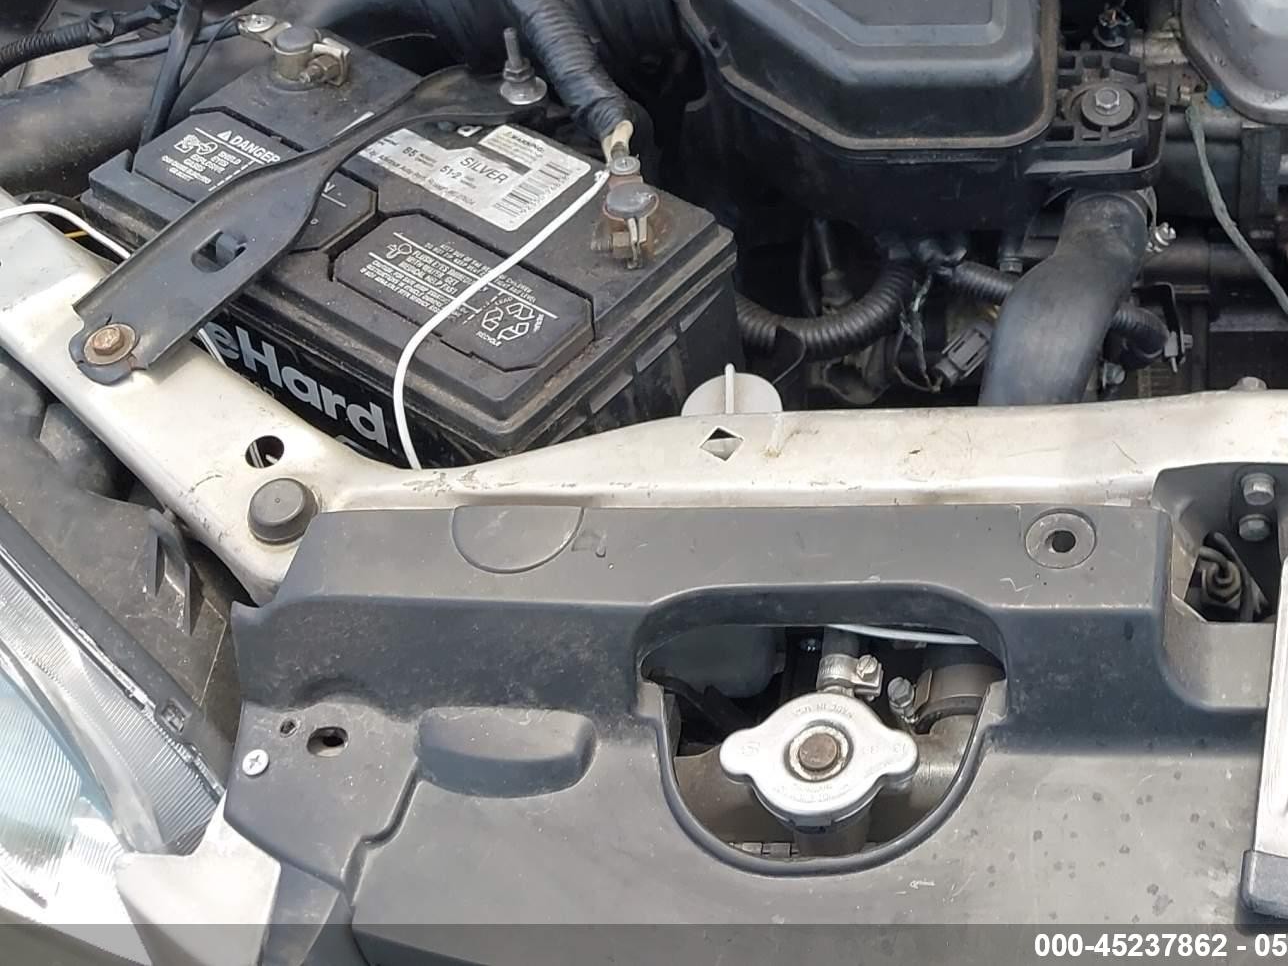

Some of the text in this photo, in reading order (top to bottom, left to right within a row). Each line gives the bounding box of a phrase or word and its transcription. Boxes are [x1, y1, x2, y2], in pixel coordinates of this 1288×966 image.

[229, 135, 281, 163] DANGER
[460, 157, 509, 179] SILVER
[204, 322, 389, 449] eHard
